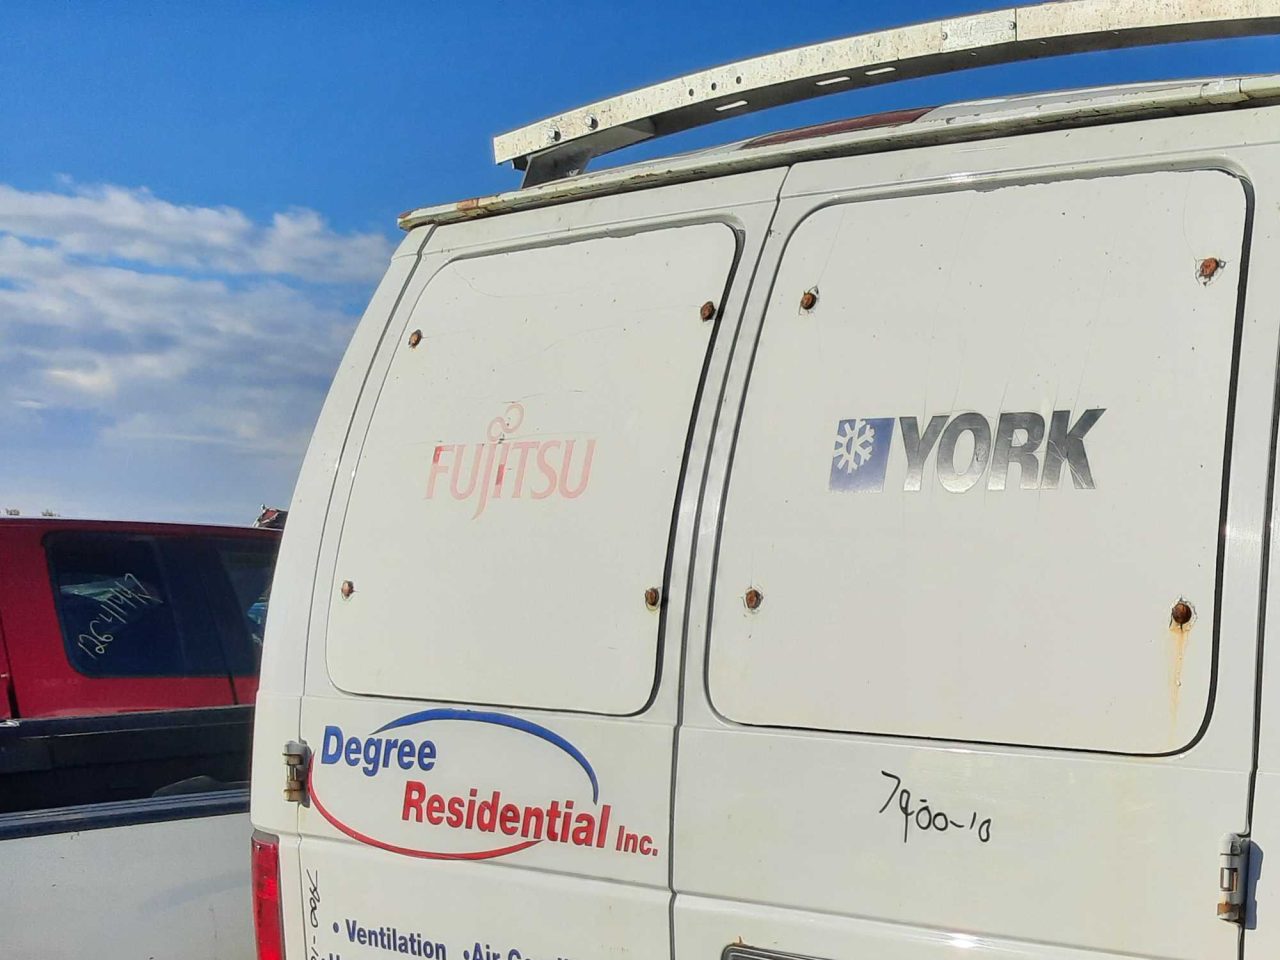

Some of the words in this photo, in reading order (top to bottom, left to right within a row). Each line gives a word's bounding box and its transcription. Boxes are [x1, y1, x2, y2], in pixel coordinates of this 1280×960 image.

[424, 438, 599, 520] FUJITSU
[898, 407, 1107, 493] YORK
[320, 725, 438, 777] Degree
[401, 780, 612, 849] Residential
[615, 824, 660, 857] Inc.
